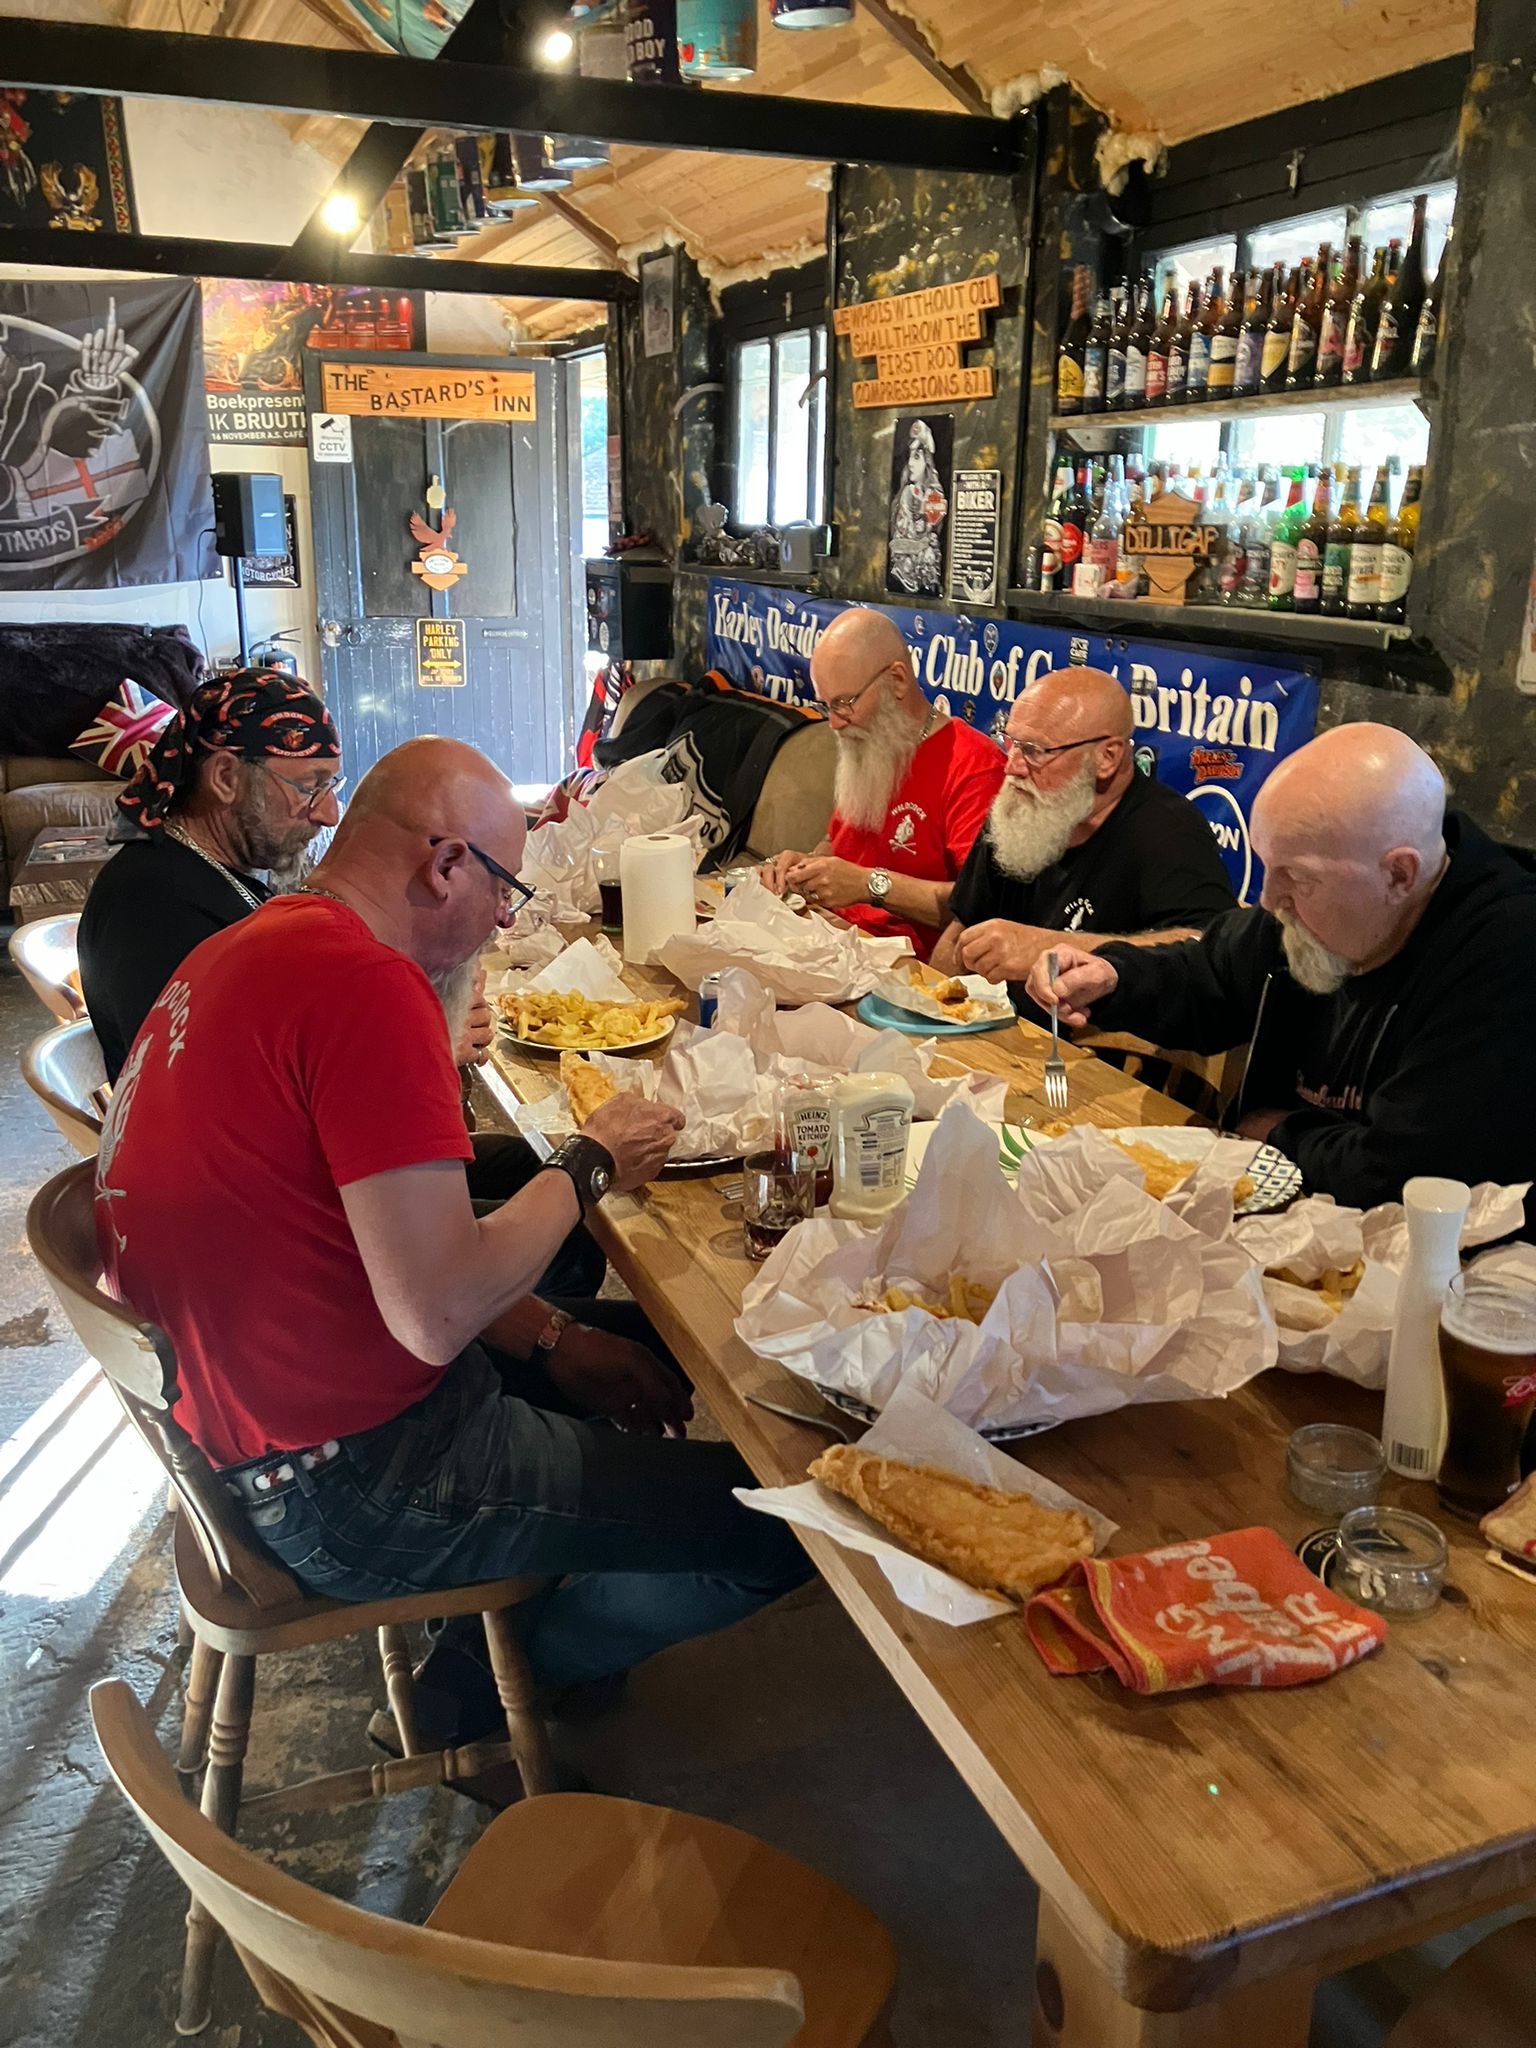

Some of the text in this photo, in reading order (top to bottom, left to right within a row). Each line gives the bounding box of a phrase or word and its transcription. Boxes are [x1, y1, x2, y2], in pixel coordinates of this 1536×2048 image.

[894, 285, 964, 321] WITHOUT
[853, 312, 976, 355] SHALL THROW THE
[879, 351, 921, 376] FIRST
[330, 372, 531, 412] THE BASTARD'S INN
[855, 373, 959, 404] COMPRESSIONS
[209, 413, 230, 430] IK
[222, 431, 267, 440] NOVEMBER
[319, 442, 346, 451] CCTV
[957, 490, 995, 511] BIKER
[0, 520, 72, 553] TARDS
[1125, 526, 1219, 555] DILLIGAF
[425, 624, 457, 635] HARLEY
[423, 635, 459, 647] PARKING
[430, 648, 453, 659] ONLY
[714, 593, 764, 657] Harley
[926, 633, 985, 697] Club
[989, 645, 1024, 702] of
[1130, 663, 1279, 752] Britain
[156, 979, 192, 1069] DCOCK
[799, 1110, 828, 1121] HEINZ
[796, 1123, 830, 1134] TOMATO
[798, 1132, 828, 1141] KETCHUP
